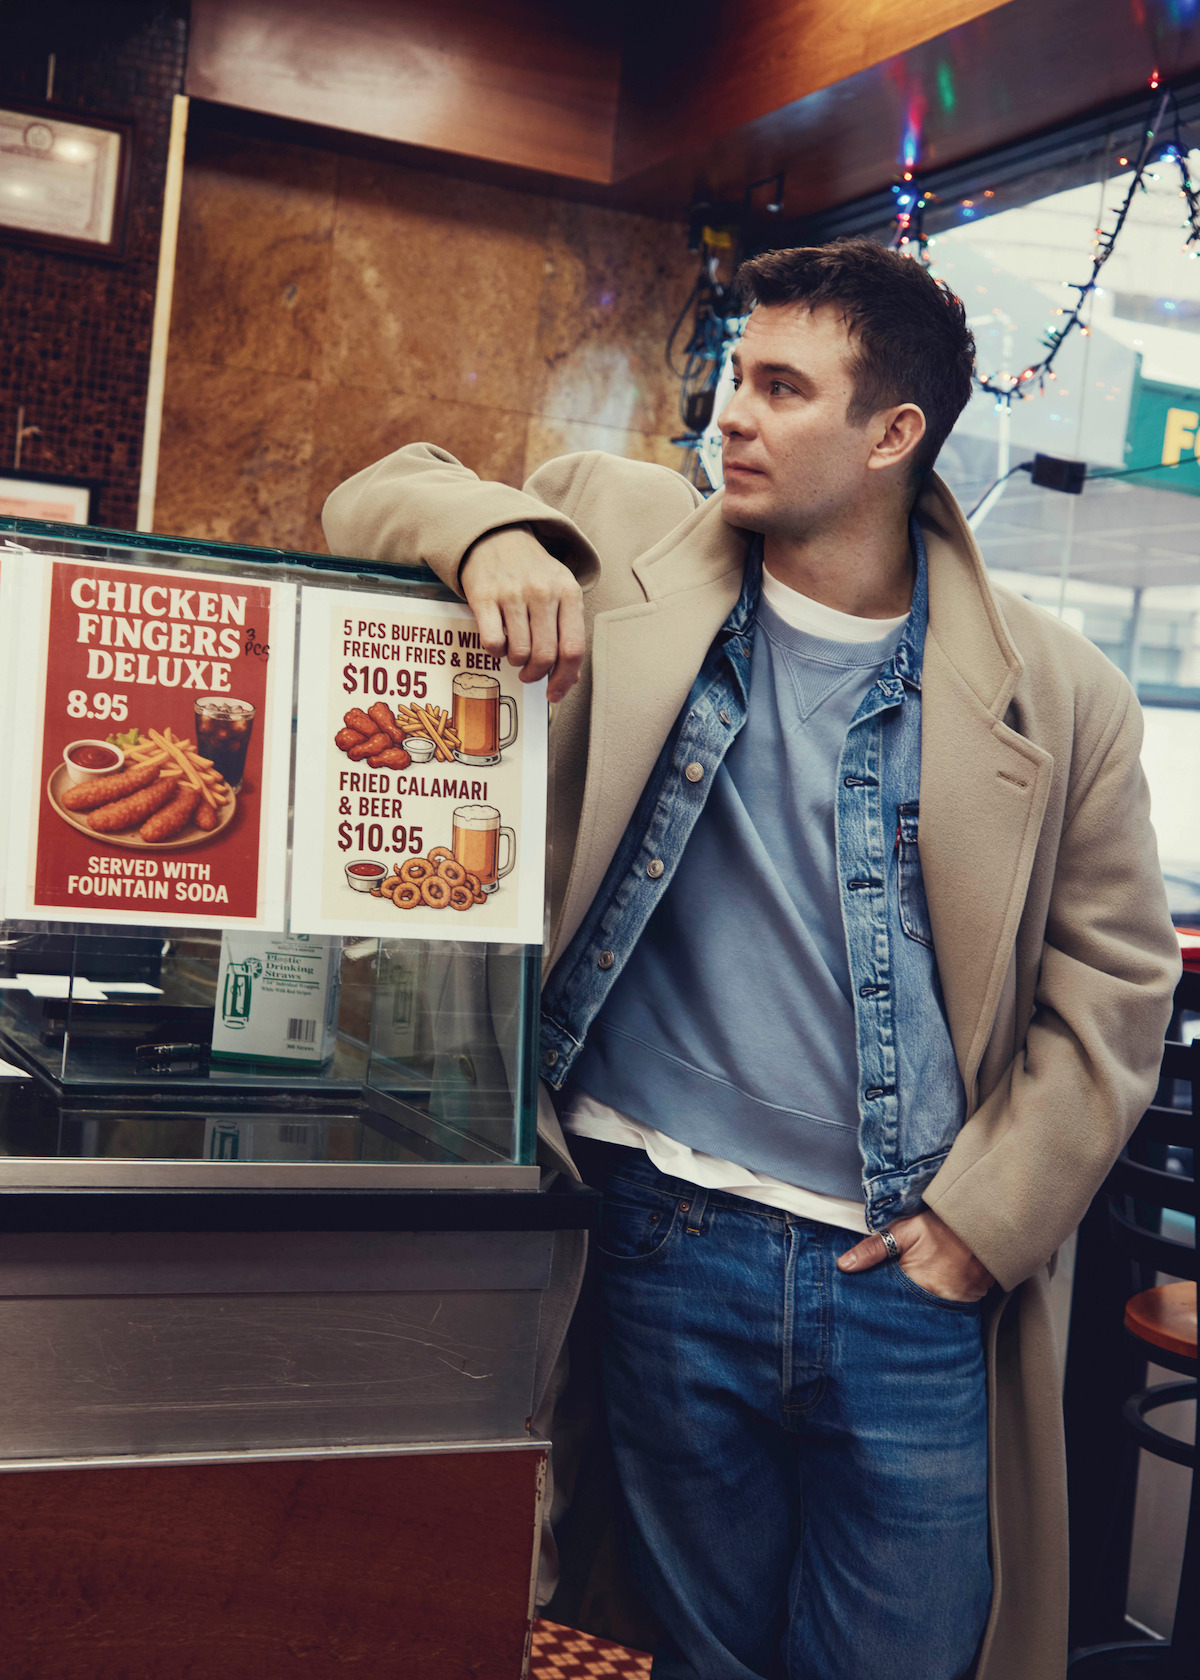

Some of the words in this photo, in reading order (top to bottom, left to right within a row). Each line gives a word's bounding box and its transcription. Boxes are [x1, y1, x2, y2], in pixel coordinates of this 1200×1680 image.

[1161, 407, 1200, 468] F
[70, 577, 248, 626] CHICKEN
[76, 612, 241, 659] FINGERS
[246, 628, 256, 641] 3
[343, 619, 353, 636] 5
[357, 621, 387, 639] PCS
[391, 624, 454, 646] BUFFALO
[86, 648, 232, 692] DELUXE
[343, 640, 401, 661] FRENCH
[406, 646, 446, 666] FRIES
[450, 652, 461, 667] &
[466, 651, 501, 672] BEER
[342, 662, 428, 699] $10.95
[66, 689, 129, 721] 8.95
[339, 771, 390, 794] FRIED
[396, 775, 488, 801] CALAMARI
[338, 796, 352, 815] &
[358, 796, 403, 819] BEER
[337, 819, 424, 854] $10.95
[87, 856, 159, 877] SERVED
[162, 861, 211, 881] WITH
[67, 875, 169, 900] FOUNTAIN
[175, 882, 229, 904] SODA
[264, 970, 302, 980] Straws
[266, 962, 314, 975] Drinking
